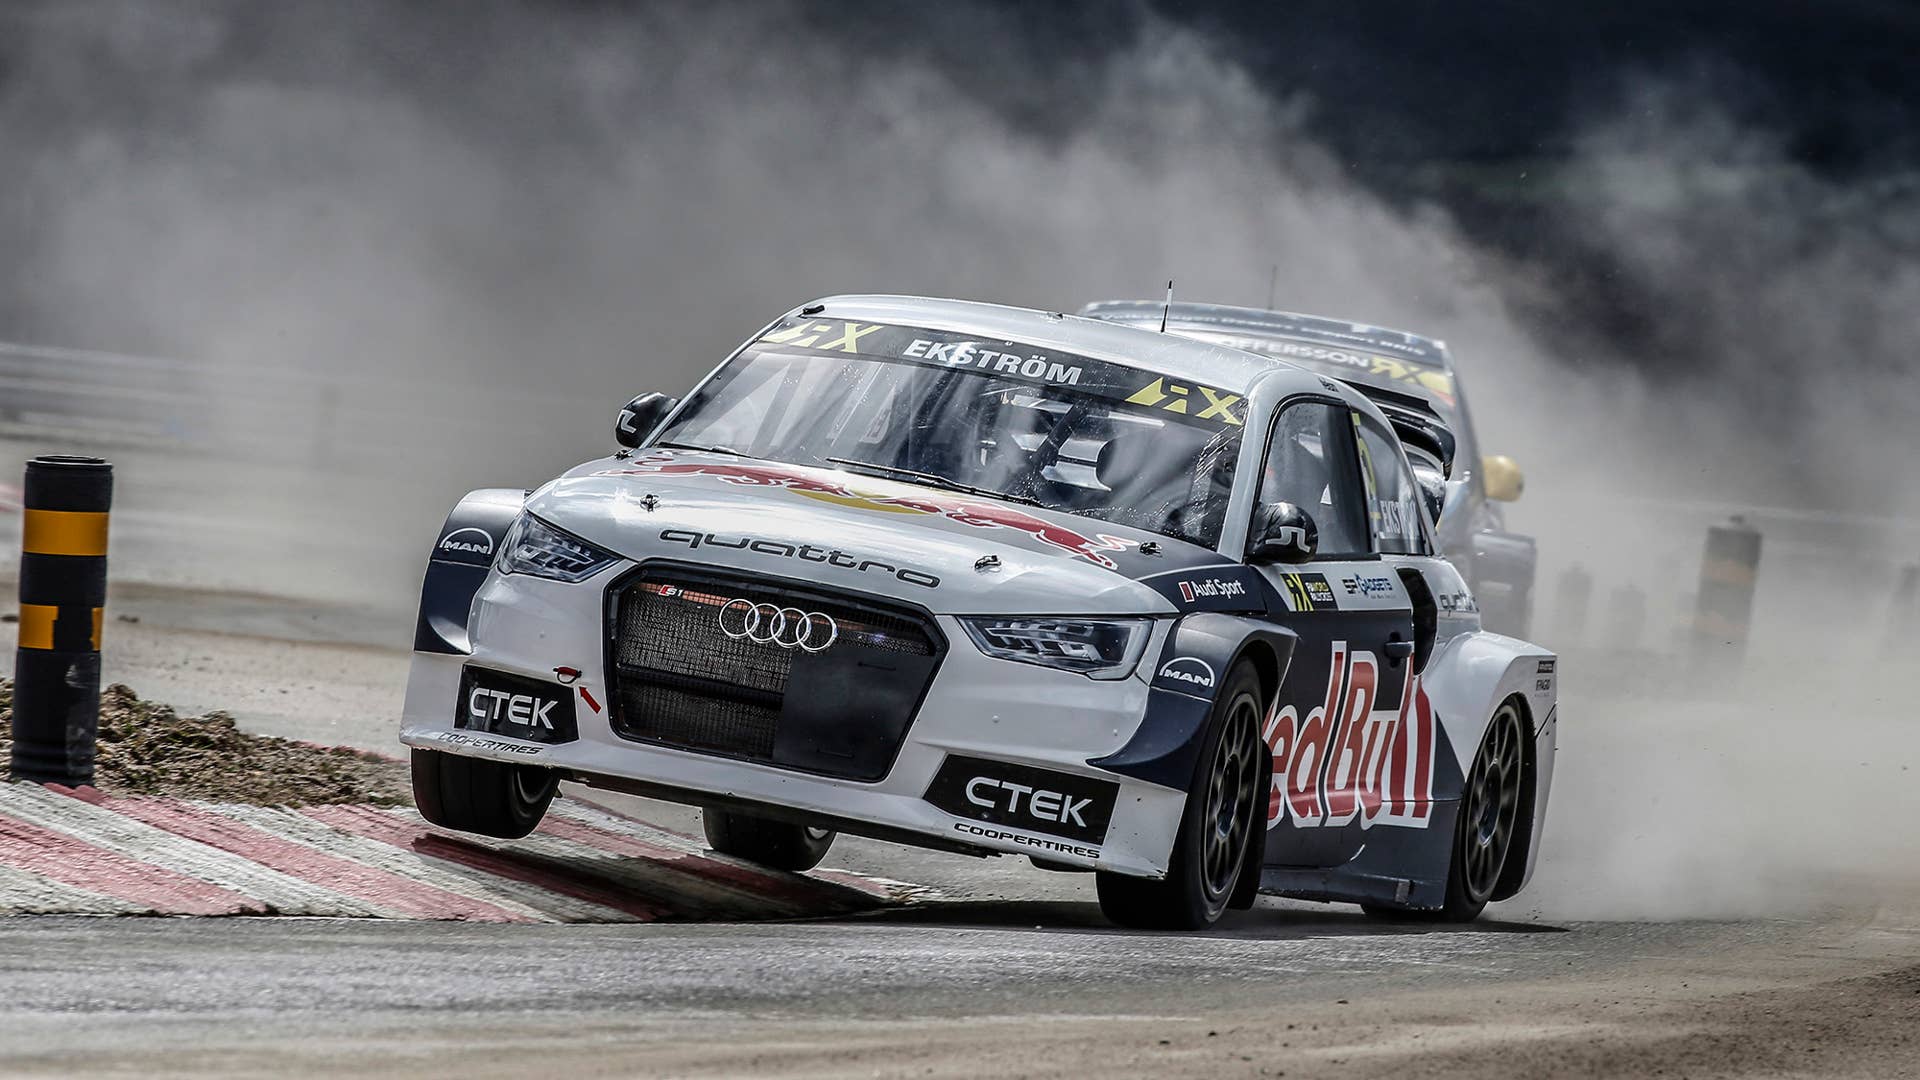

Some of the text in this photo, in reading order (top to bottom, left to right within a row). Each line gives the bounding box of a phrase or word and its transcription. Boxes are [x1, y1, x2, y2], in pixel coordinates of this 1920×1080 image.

[902, 339, 1083, 386] EKSTRÖM
[443, 540, 489, 554] MAN
[658, 528, 942, 589] quattro
[1190, 578, 1246, 600] Audi Sport
[1164, 668, 1211, 687] MAN
[469, 687, 559, 731] CTEK
[1263, 640, 1438, 831] ed Bull
[965, 776, 1093, 828] CTEK
[953, 822, 1101, 859] COOPERTIRES
